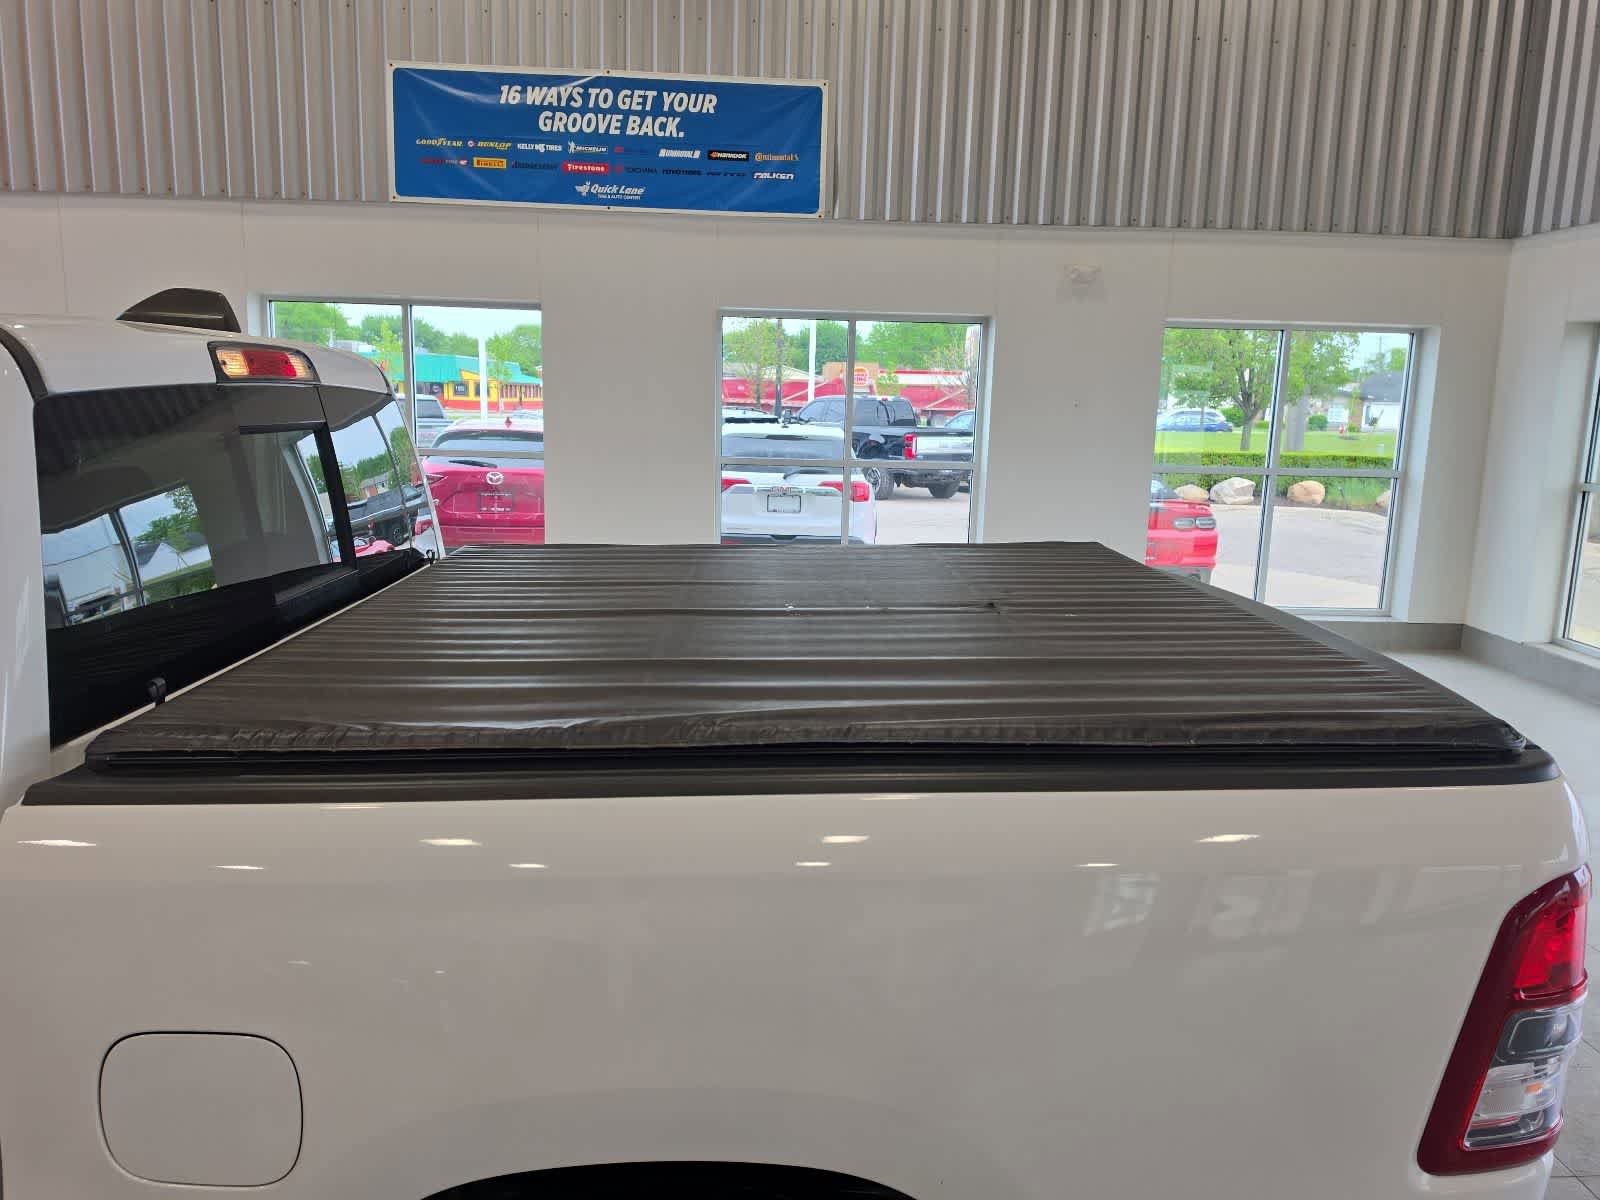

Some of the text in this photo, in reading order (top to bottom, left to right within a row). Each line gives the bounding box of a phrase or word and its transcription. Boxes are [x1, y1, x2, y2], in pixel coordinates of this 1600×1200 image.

[499, 84, 718, 114] 16 WAYS TO GET YOUR
[538, 110, 685, 138] GROOVE BACK.
[416, 138, 463, 147] GOODYEAR
[517, 143, 562, 152] KELLY TIRES
[575, 145, 607, 153] MICHELIN
[591, 184, 645, 196] Quick Lane
